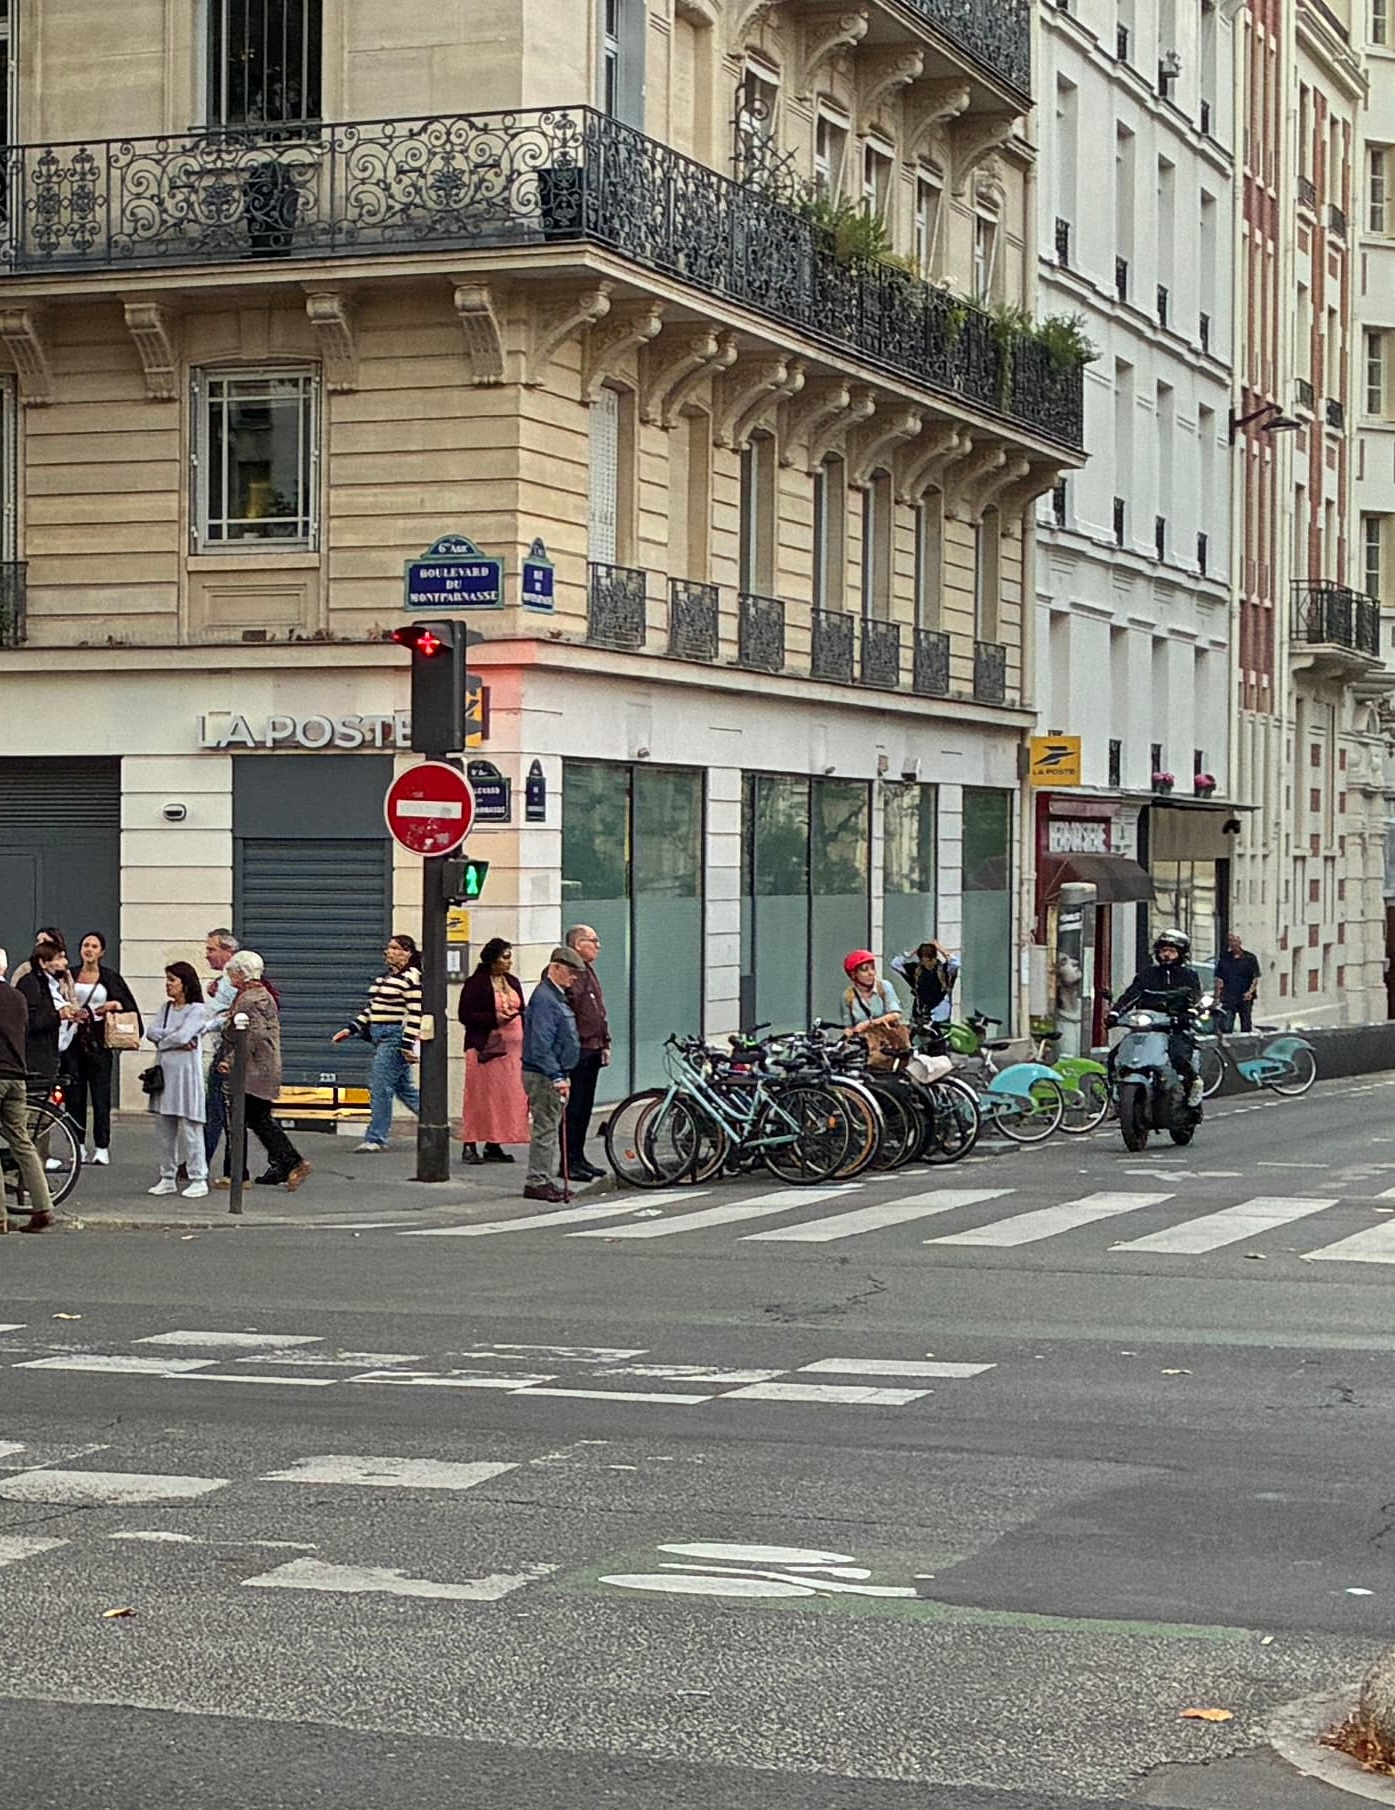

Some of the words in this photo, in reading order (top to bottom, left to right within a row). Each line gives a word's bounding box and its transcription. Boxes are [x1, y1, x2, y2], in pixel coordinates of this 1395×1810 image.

[419, 567, 489, 578] BOULEVARD
[446, 580, 462, 590] DU
[410, 591, 498, 602] MONTPARNASSE
[196, 714, 256, 749] LA
[265, 714, 413, 749] POSTE
[1046, 768, 1076, 776] POSTE
